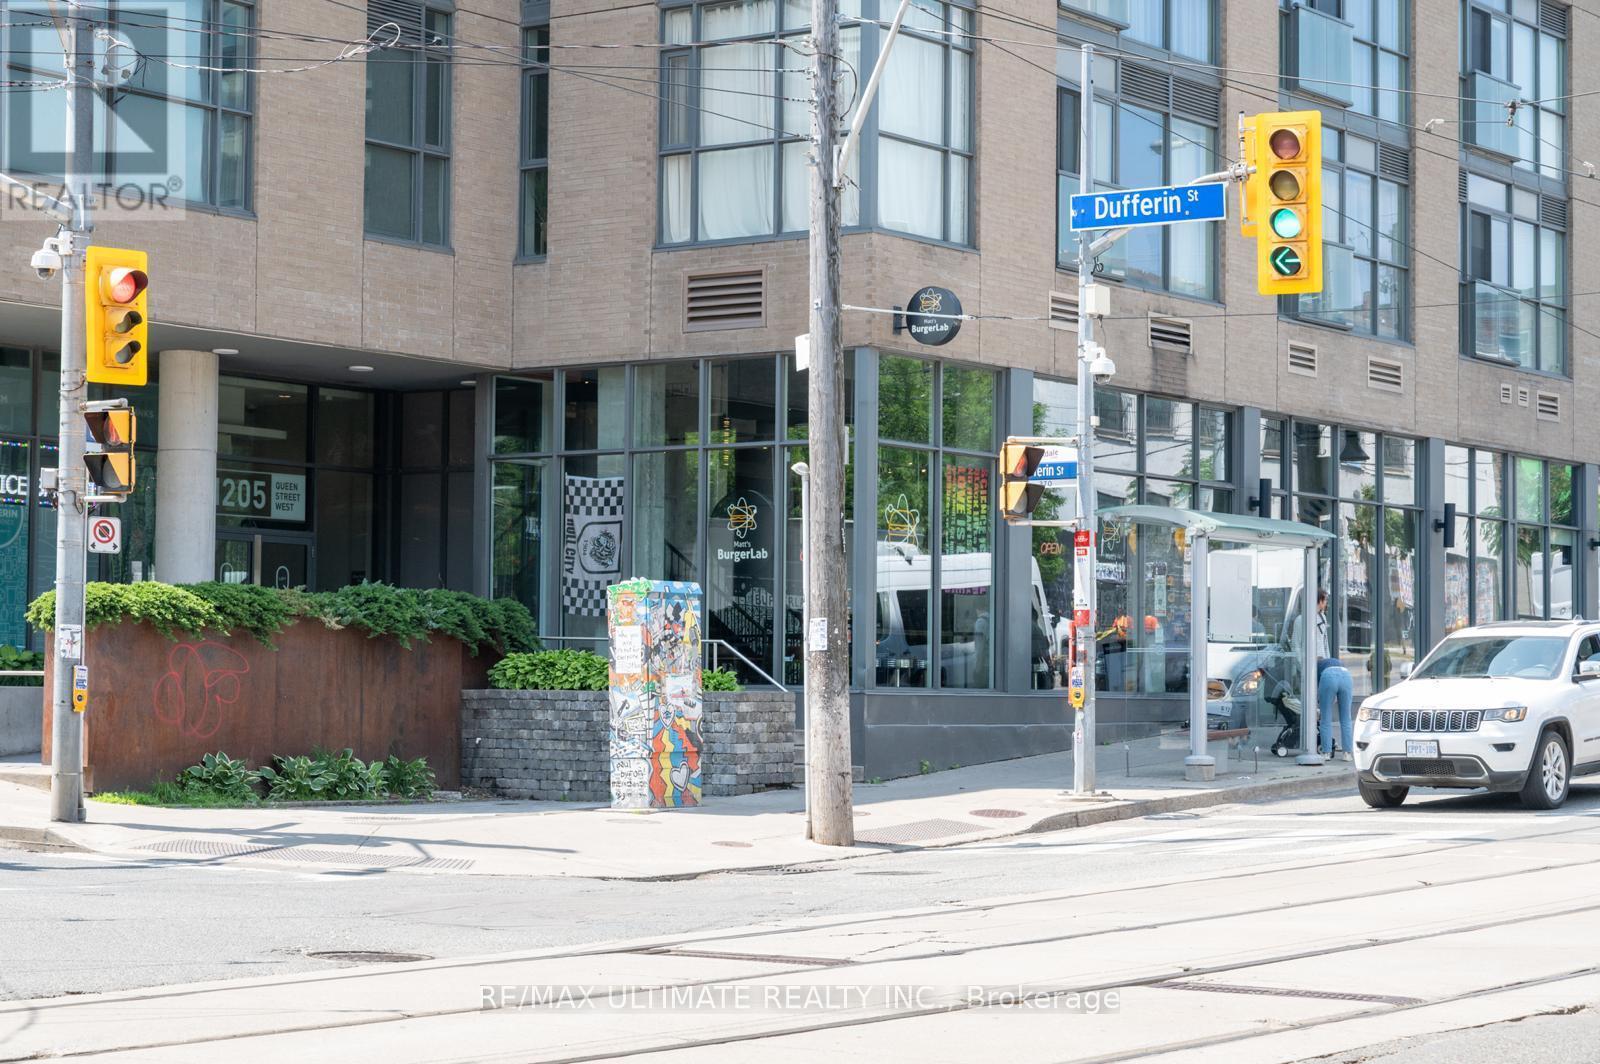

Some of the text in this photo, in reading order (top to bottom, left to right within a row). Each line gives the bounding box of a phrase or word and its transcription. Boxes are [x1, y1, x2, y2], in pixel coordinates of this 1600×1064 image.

[1094, 189, 1199, 220] Dufferin St
[911, 323, 949, 334] BurgerLab
[1056, 465, 1064, 476] St
[275, 481, 299, 491] QUEEN
[956, 466, 966, 515] LOVE
[275, 492, 301, 502] STREET
[275, 502, 294, 512] WEST
[956, 519, 966, 540] IS
[733, 540, 751, 548] Matt's
[1040, 542, 1064, 555] OPEN
[564, 547, 576, 575] CITY
[717, 548, 769, 562] BurgerLab
